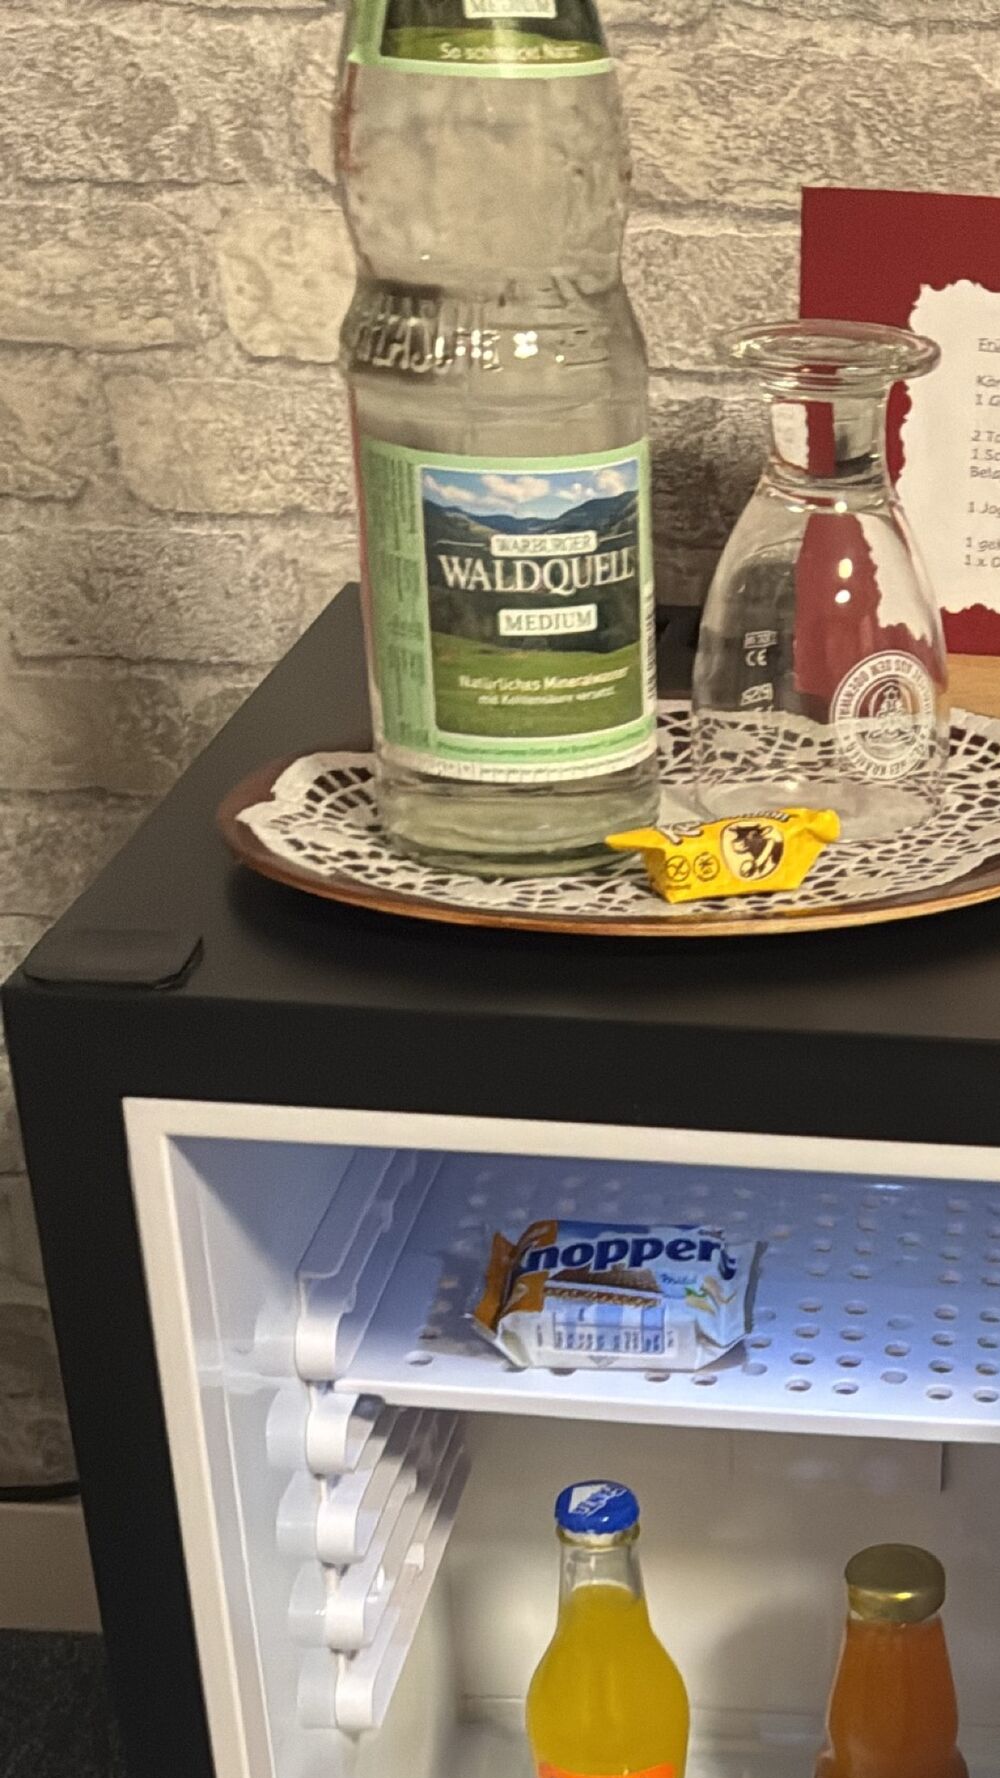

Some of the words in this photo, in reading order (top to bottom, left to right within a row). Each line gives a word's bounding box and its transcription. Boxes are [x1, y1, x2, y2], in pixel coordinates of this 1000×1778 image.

[971, 429, 981, 442] 2
[971, 448, 979, 460] 1
[967, 501, 975, 513] 1
[965, 536, 973, 548] 1
[964, 554, 972, 566] 1
[438, 547, 635, 597] WALDQUELL
[504, 610, 592, 632] MEDIUM
